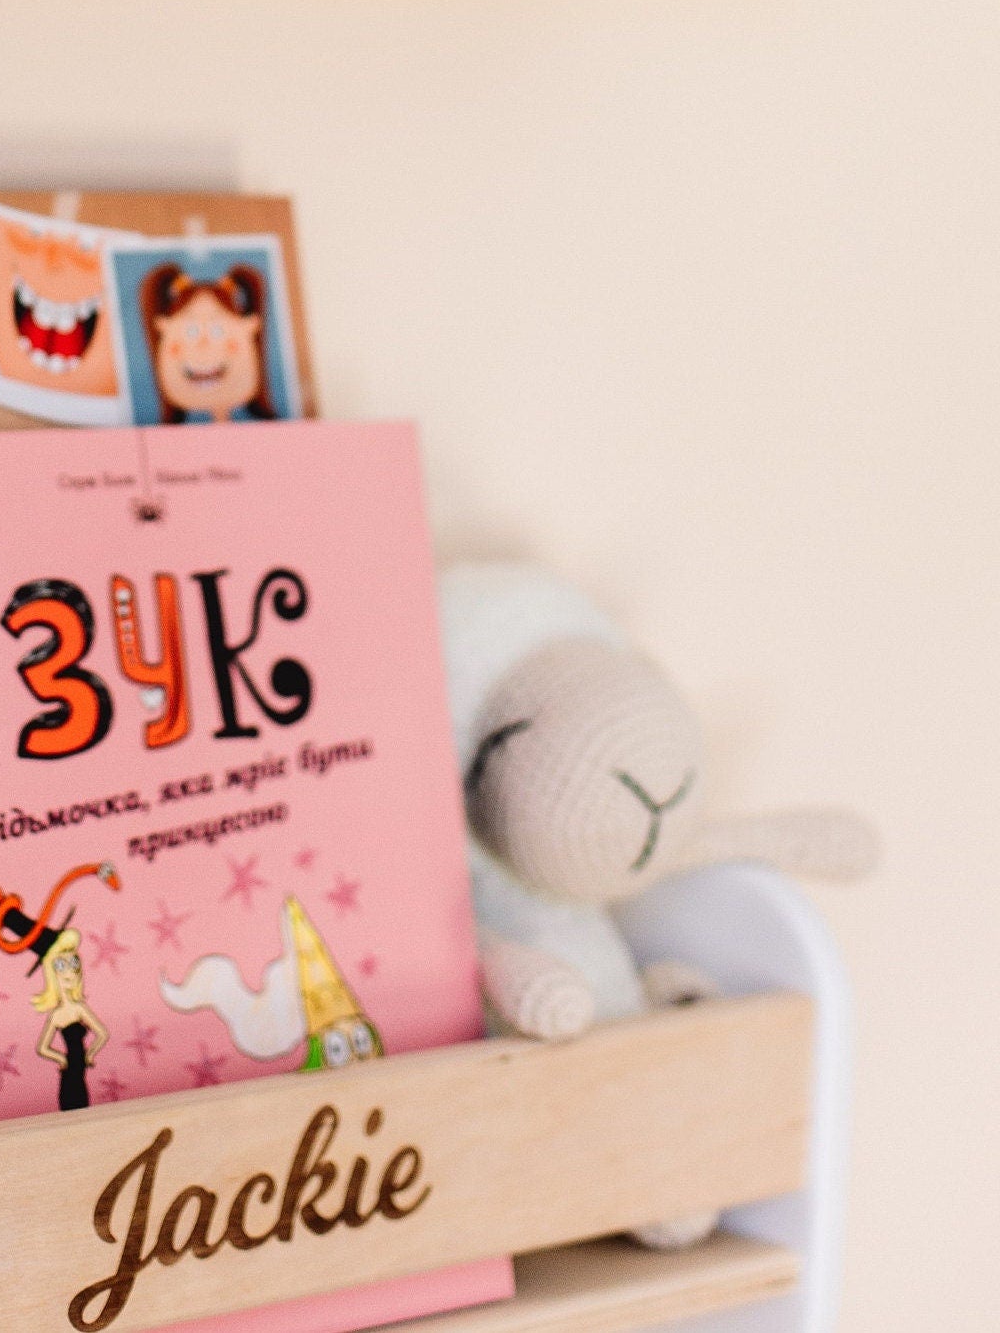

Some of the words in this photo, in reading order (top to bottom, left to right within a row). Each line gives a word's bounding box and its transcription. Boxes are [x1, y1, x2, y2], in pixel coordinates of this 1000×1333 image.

[0, 566, 312, 760] ЗУК
[160, 774, 214, 805] яка
[226, 756, 288, 793] мріє
[299, 738, 374, 773] бути
[67, 1104, 433, 1333] Jackie
